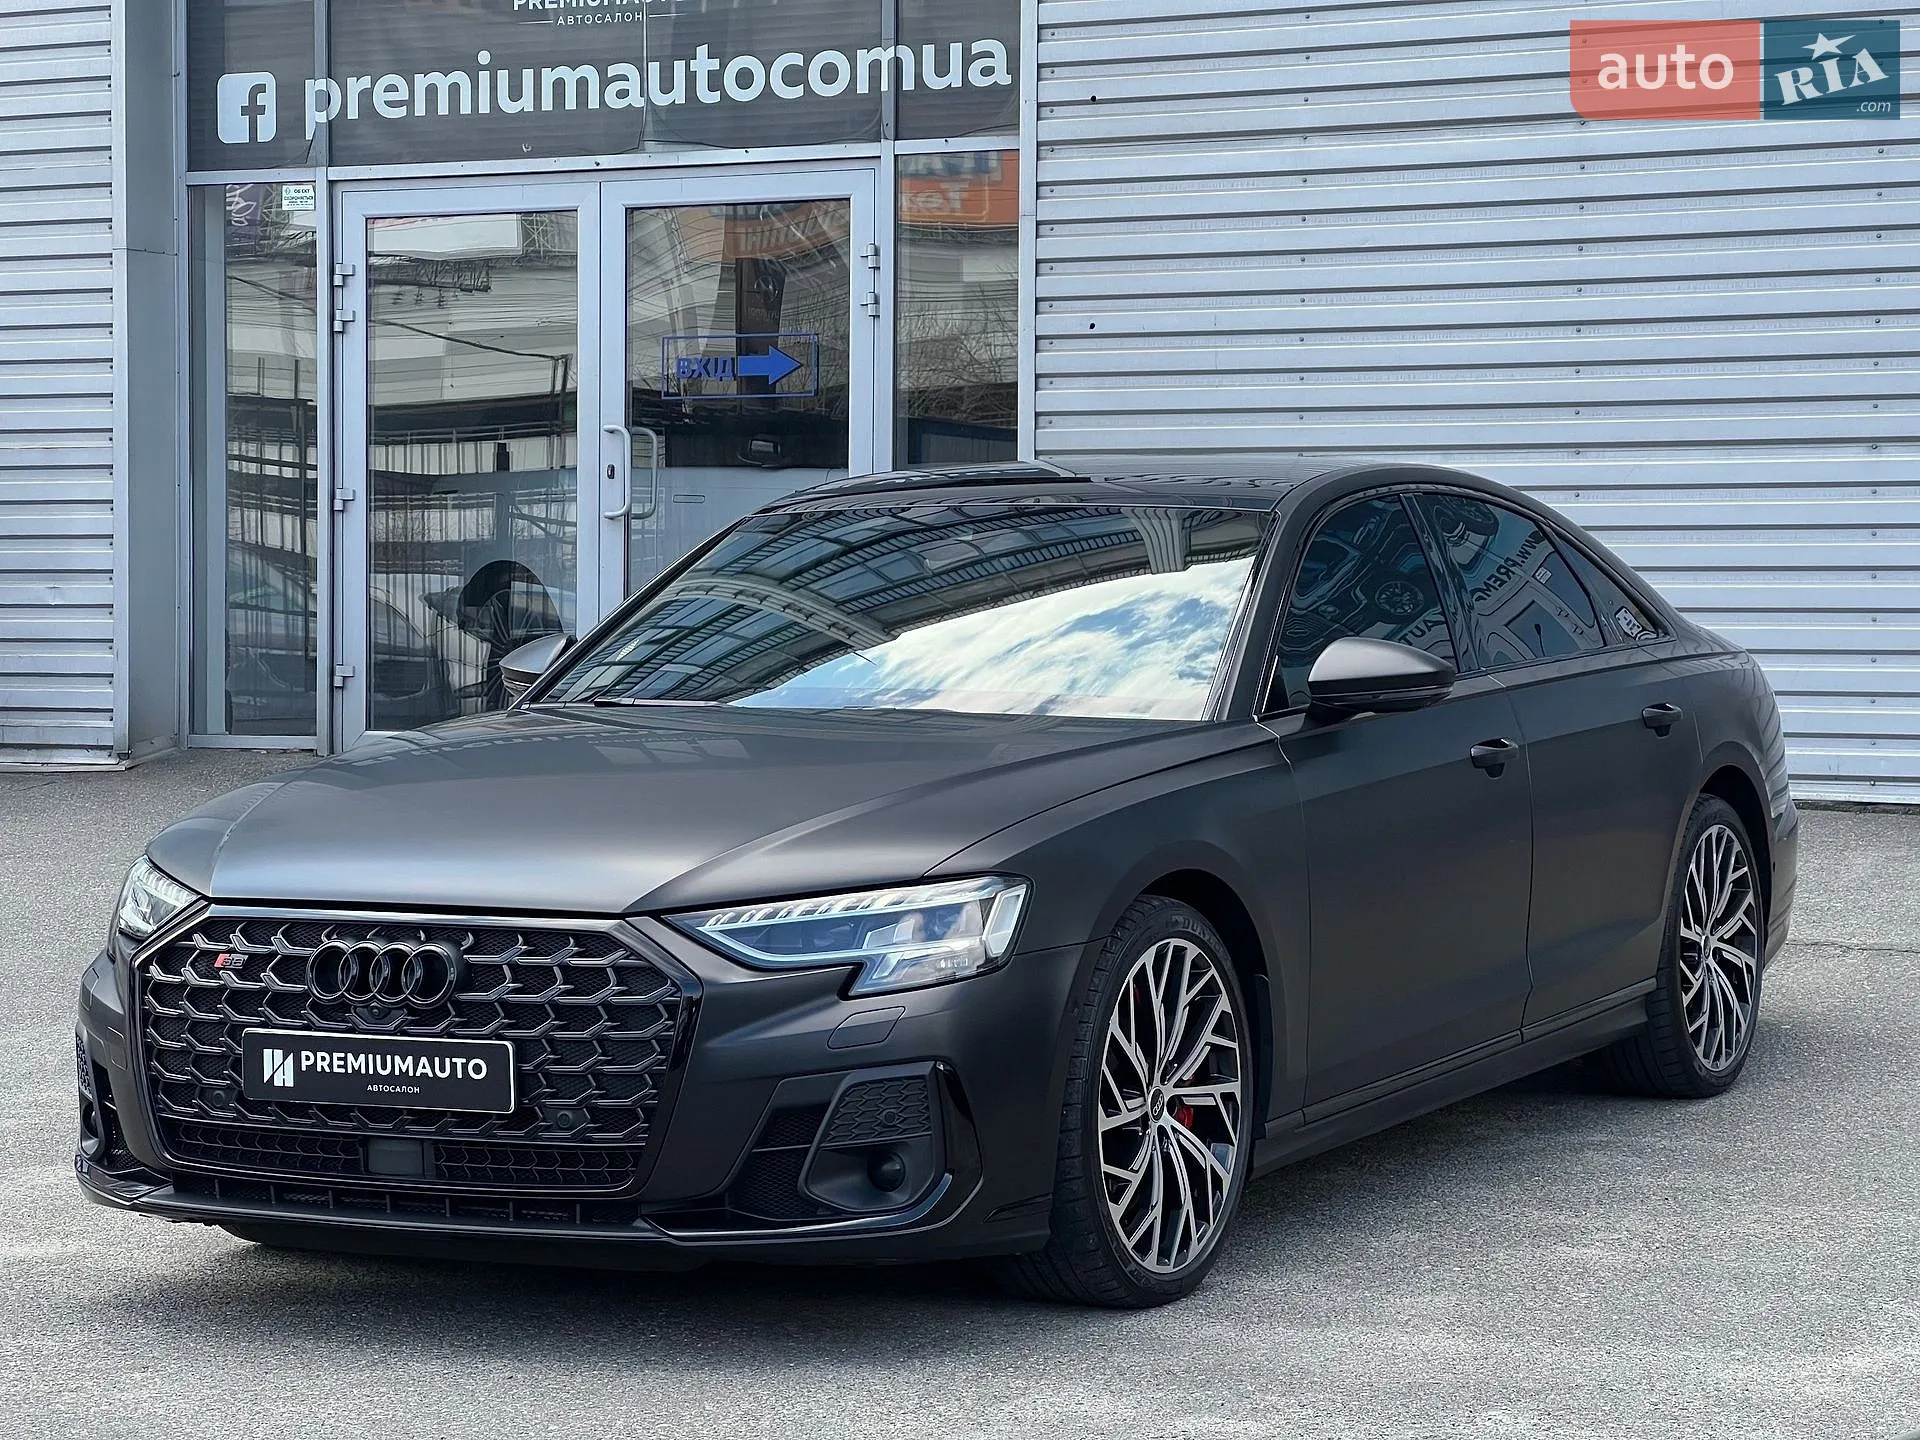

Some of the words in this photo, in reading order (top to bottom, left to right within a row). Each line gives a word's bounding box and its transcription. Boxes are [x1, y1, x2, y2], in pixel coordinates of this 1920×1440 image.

[556, 11, 643, 25] АВТОСАЛОН
[304, 39, 1012, 140] premiumautocomua
[300, 1051, 488, 1080] PREMIUMAUTO
[366, 1084, 420, 1094] АВТОСАЛОН
